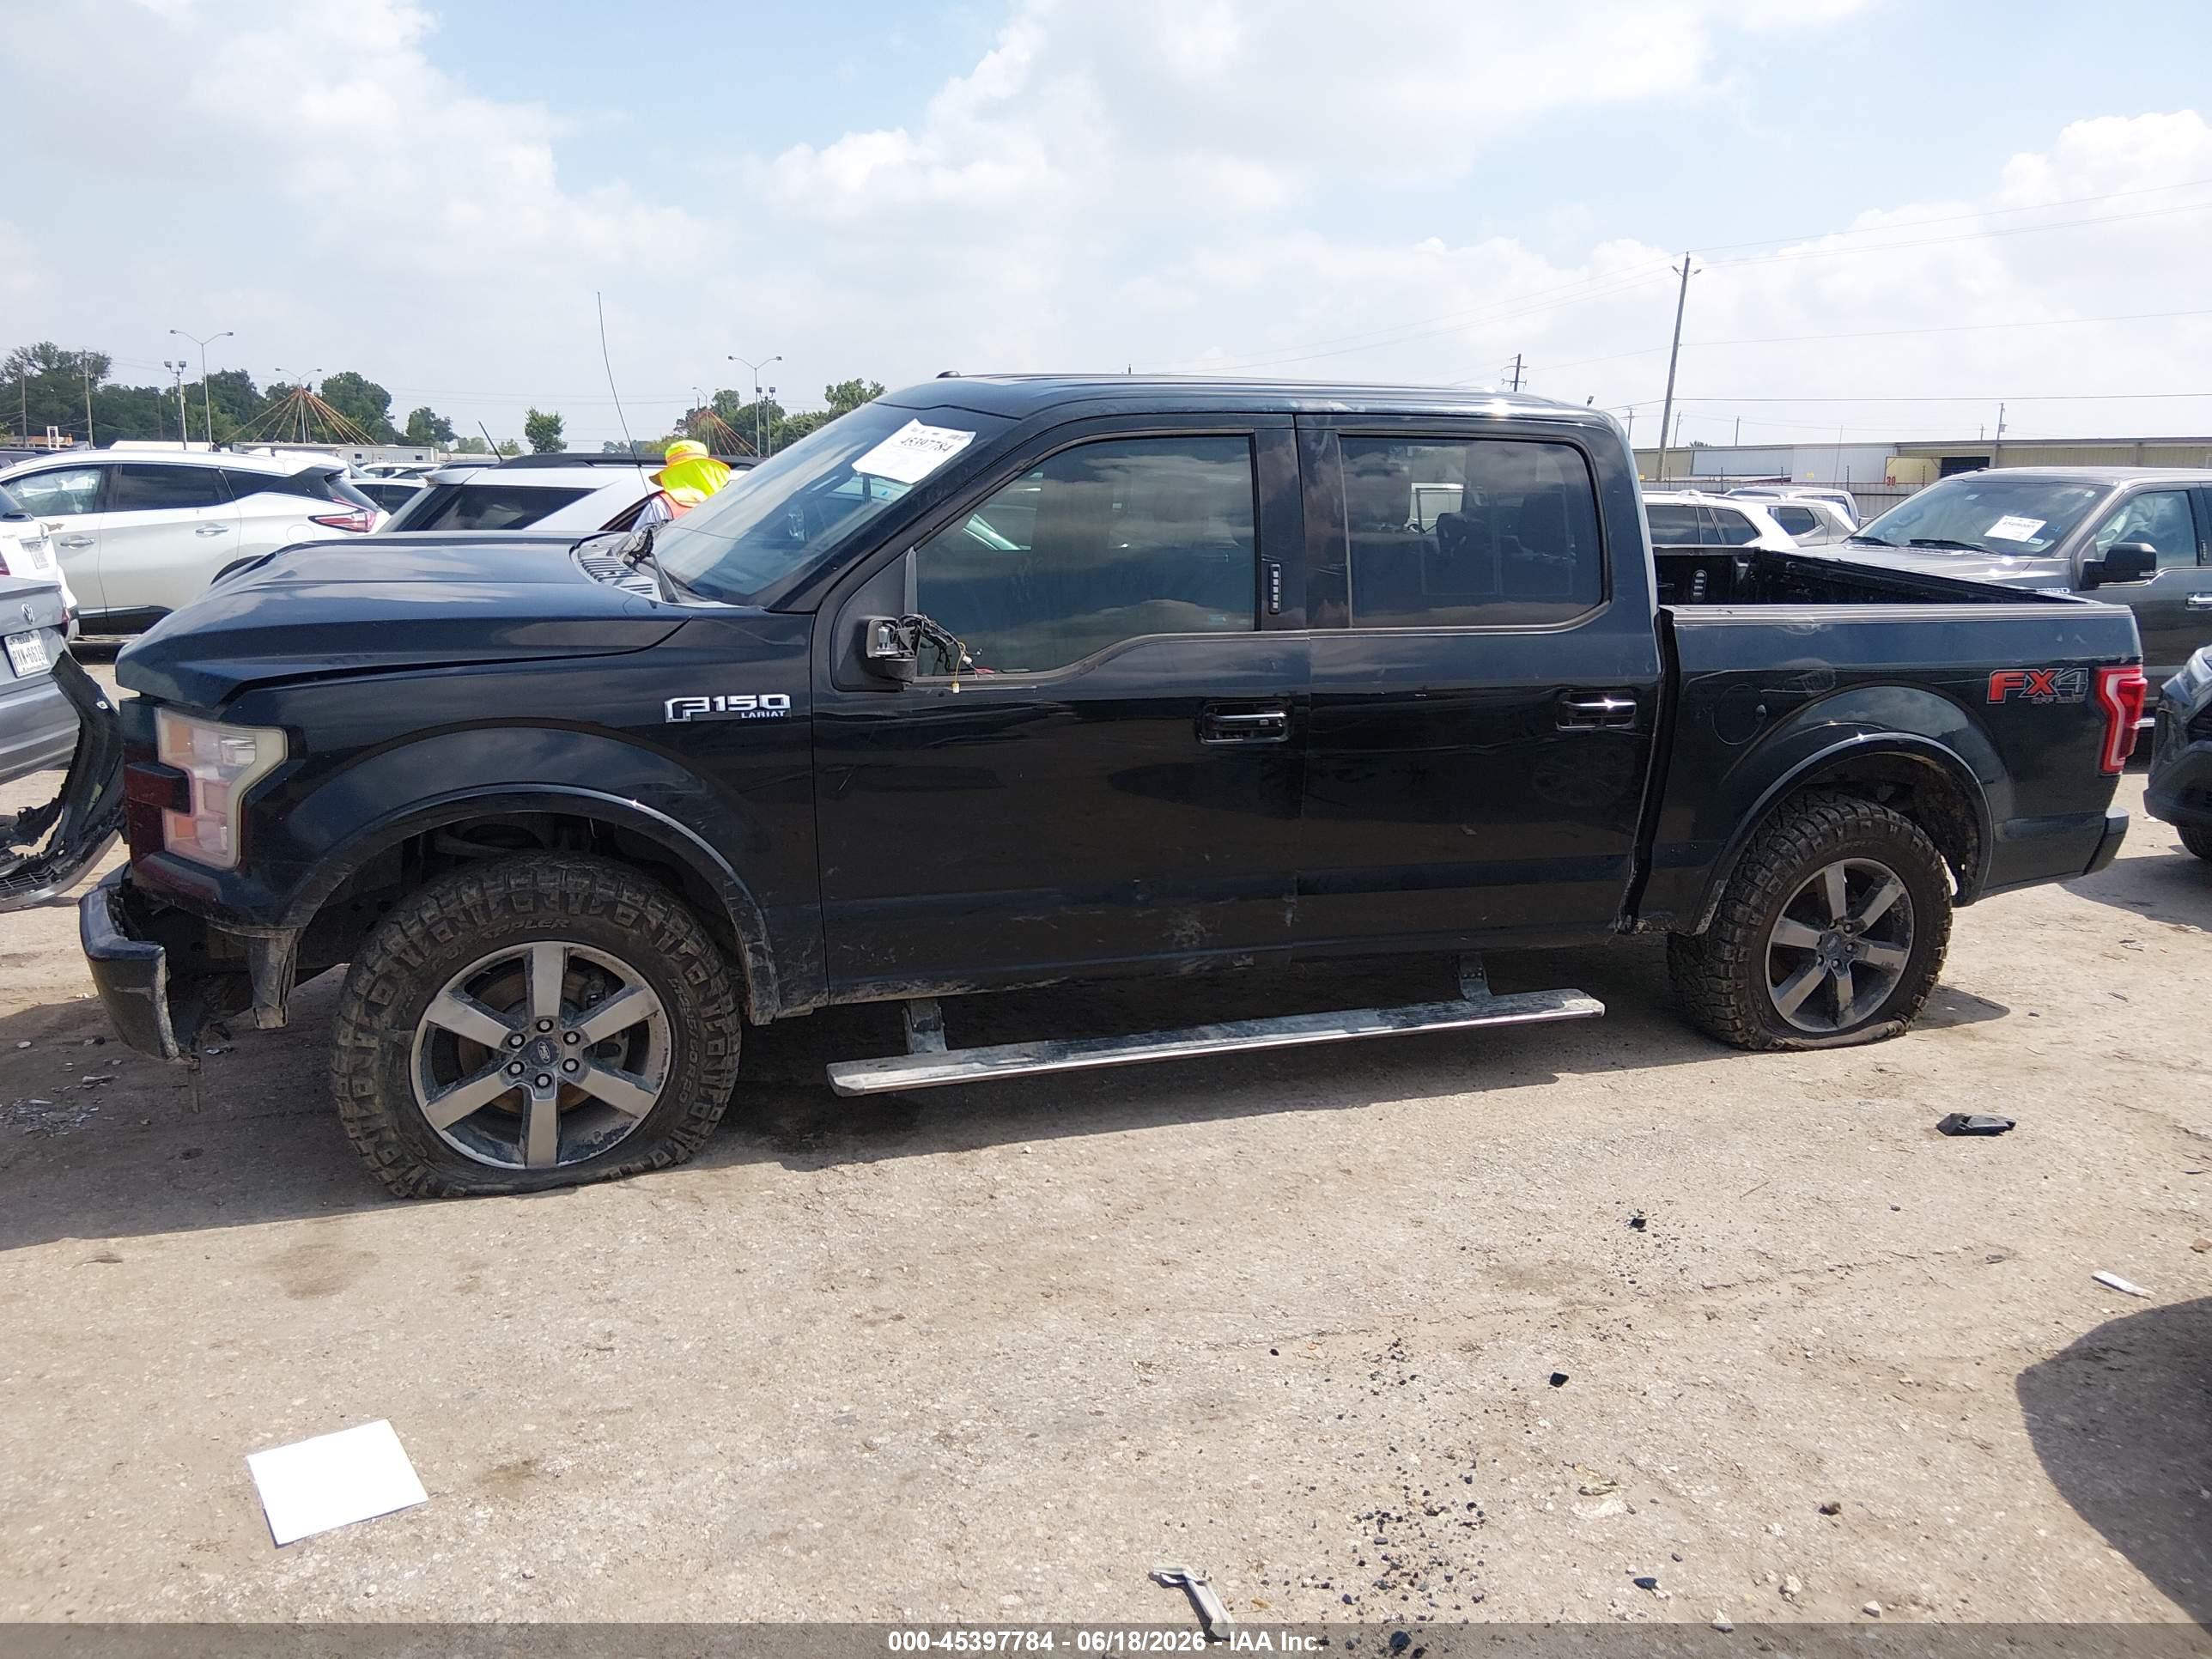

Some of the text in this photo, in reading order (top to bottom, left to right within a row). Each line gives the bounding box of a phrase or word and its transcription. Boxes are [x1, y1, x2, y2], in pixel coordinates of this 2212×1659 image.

[1887, 476, 1896, 486] 30
[1987, 668, 2088, 703] FX4
[741, 710, 787, 719] LARIAT
